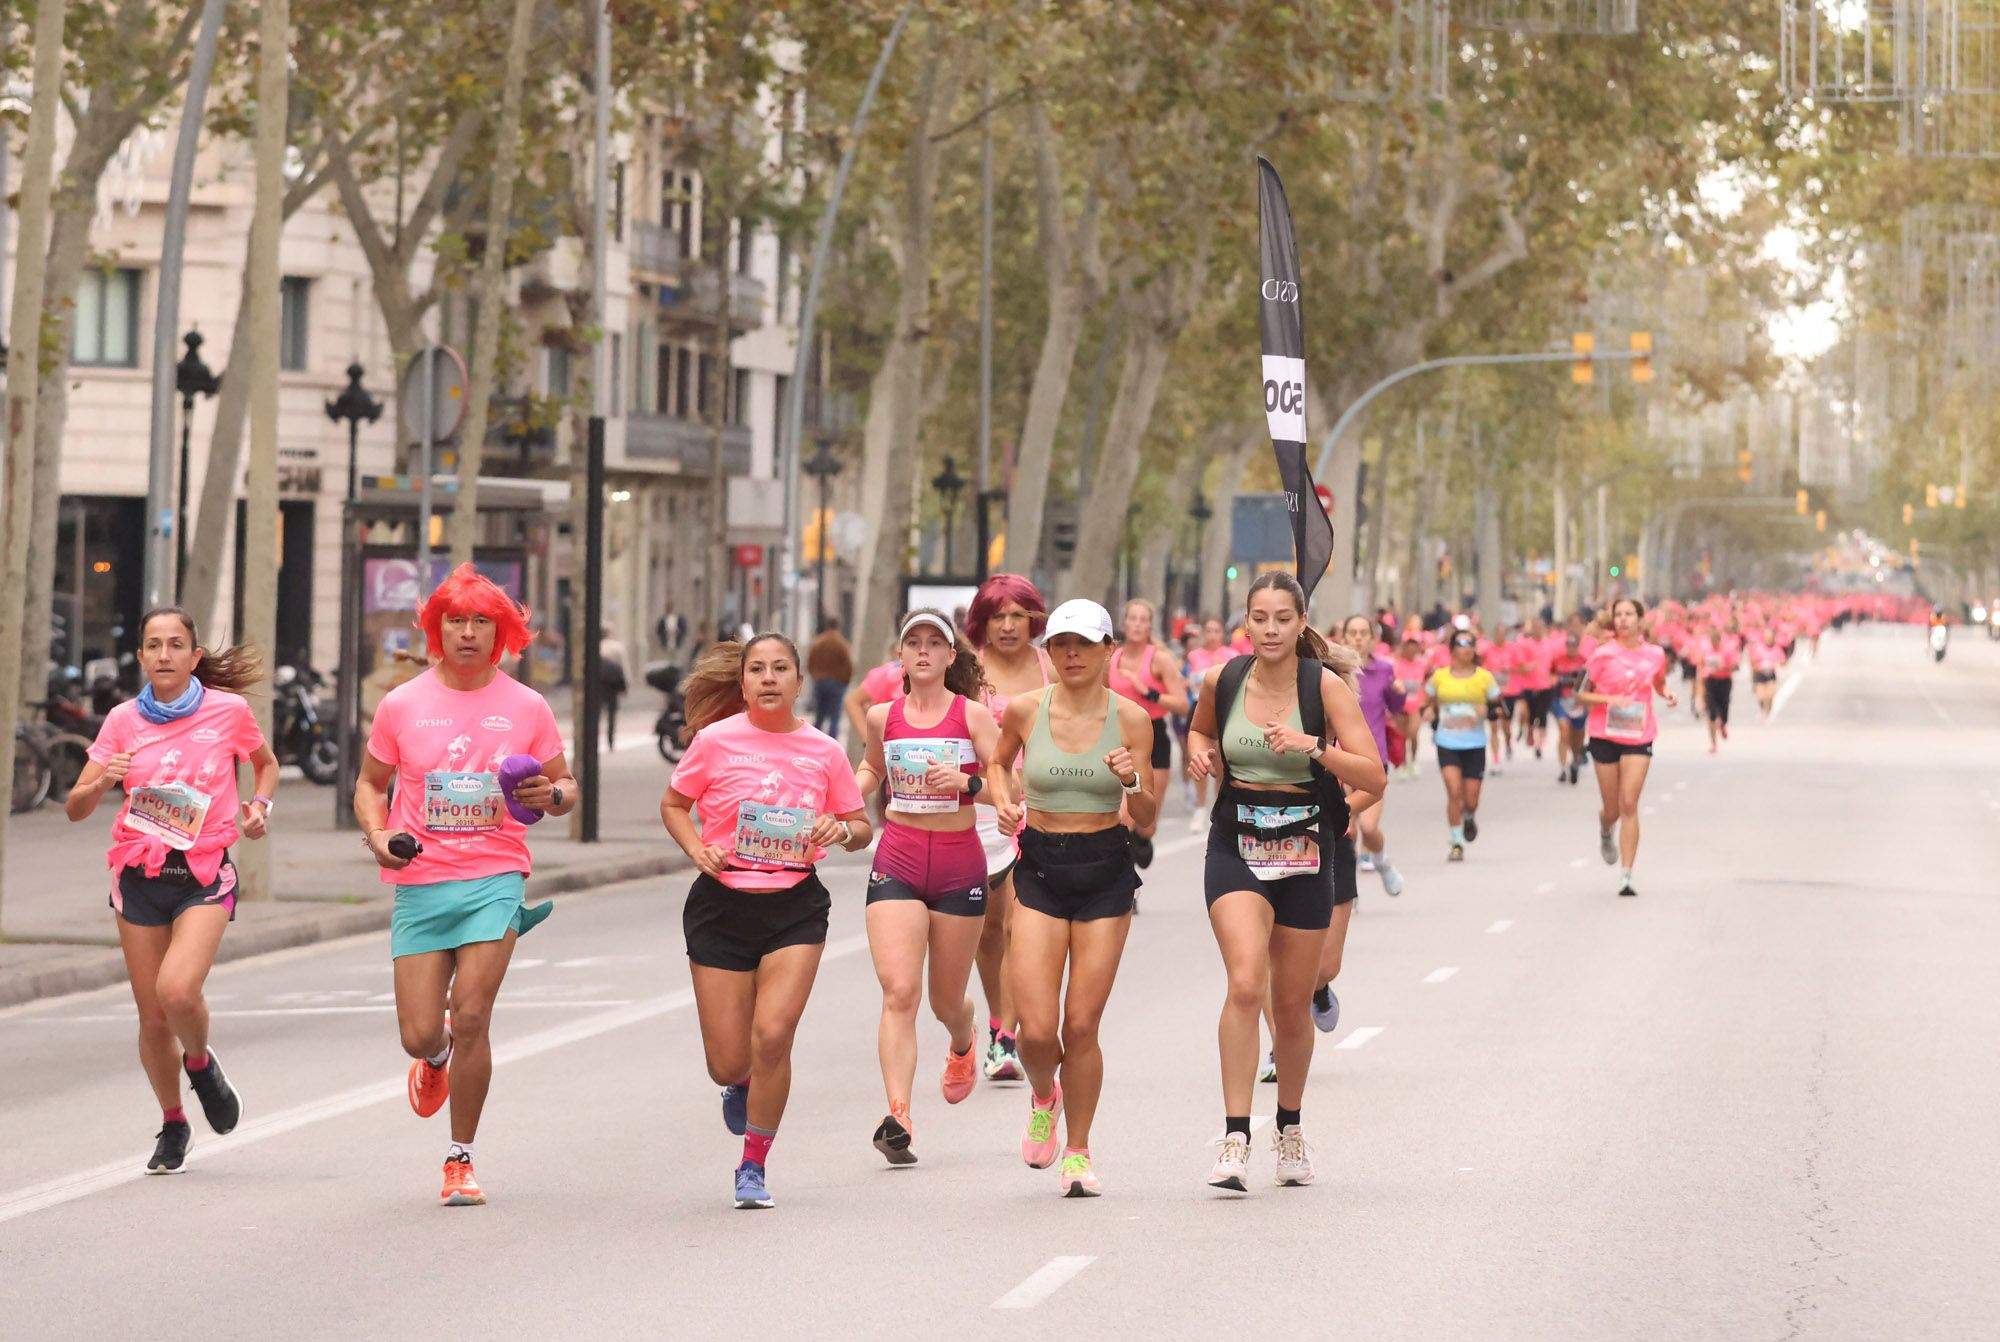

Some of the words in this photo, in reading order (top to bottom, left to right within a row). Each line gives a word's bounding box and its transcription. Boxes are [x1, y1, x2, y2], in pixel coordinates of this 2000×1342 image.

[416, 718, 452, 728] OYSHO
[728, 753, 766, 764] OYSHO
[1049, 766, 1094, 777] OYSHO
[154, 798, 182, 818] 016
[450, 804, 482, 817] 016
[760, 836, 792, 852] 016
[1263, 838, 1294, 852] 016
[764, 851, 783, 859] 20317
